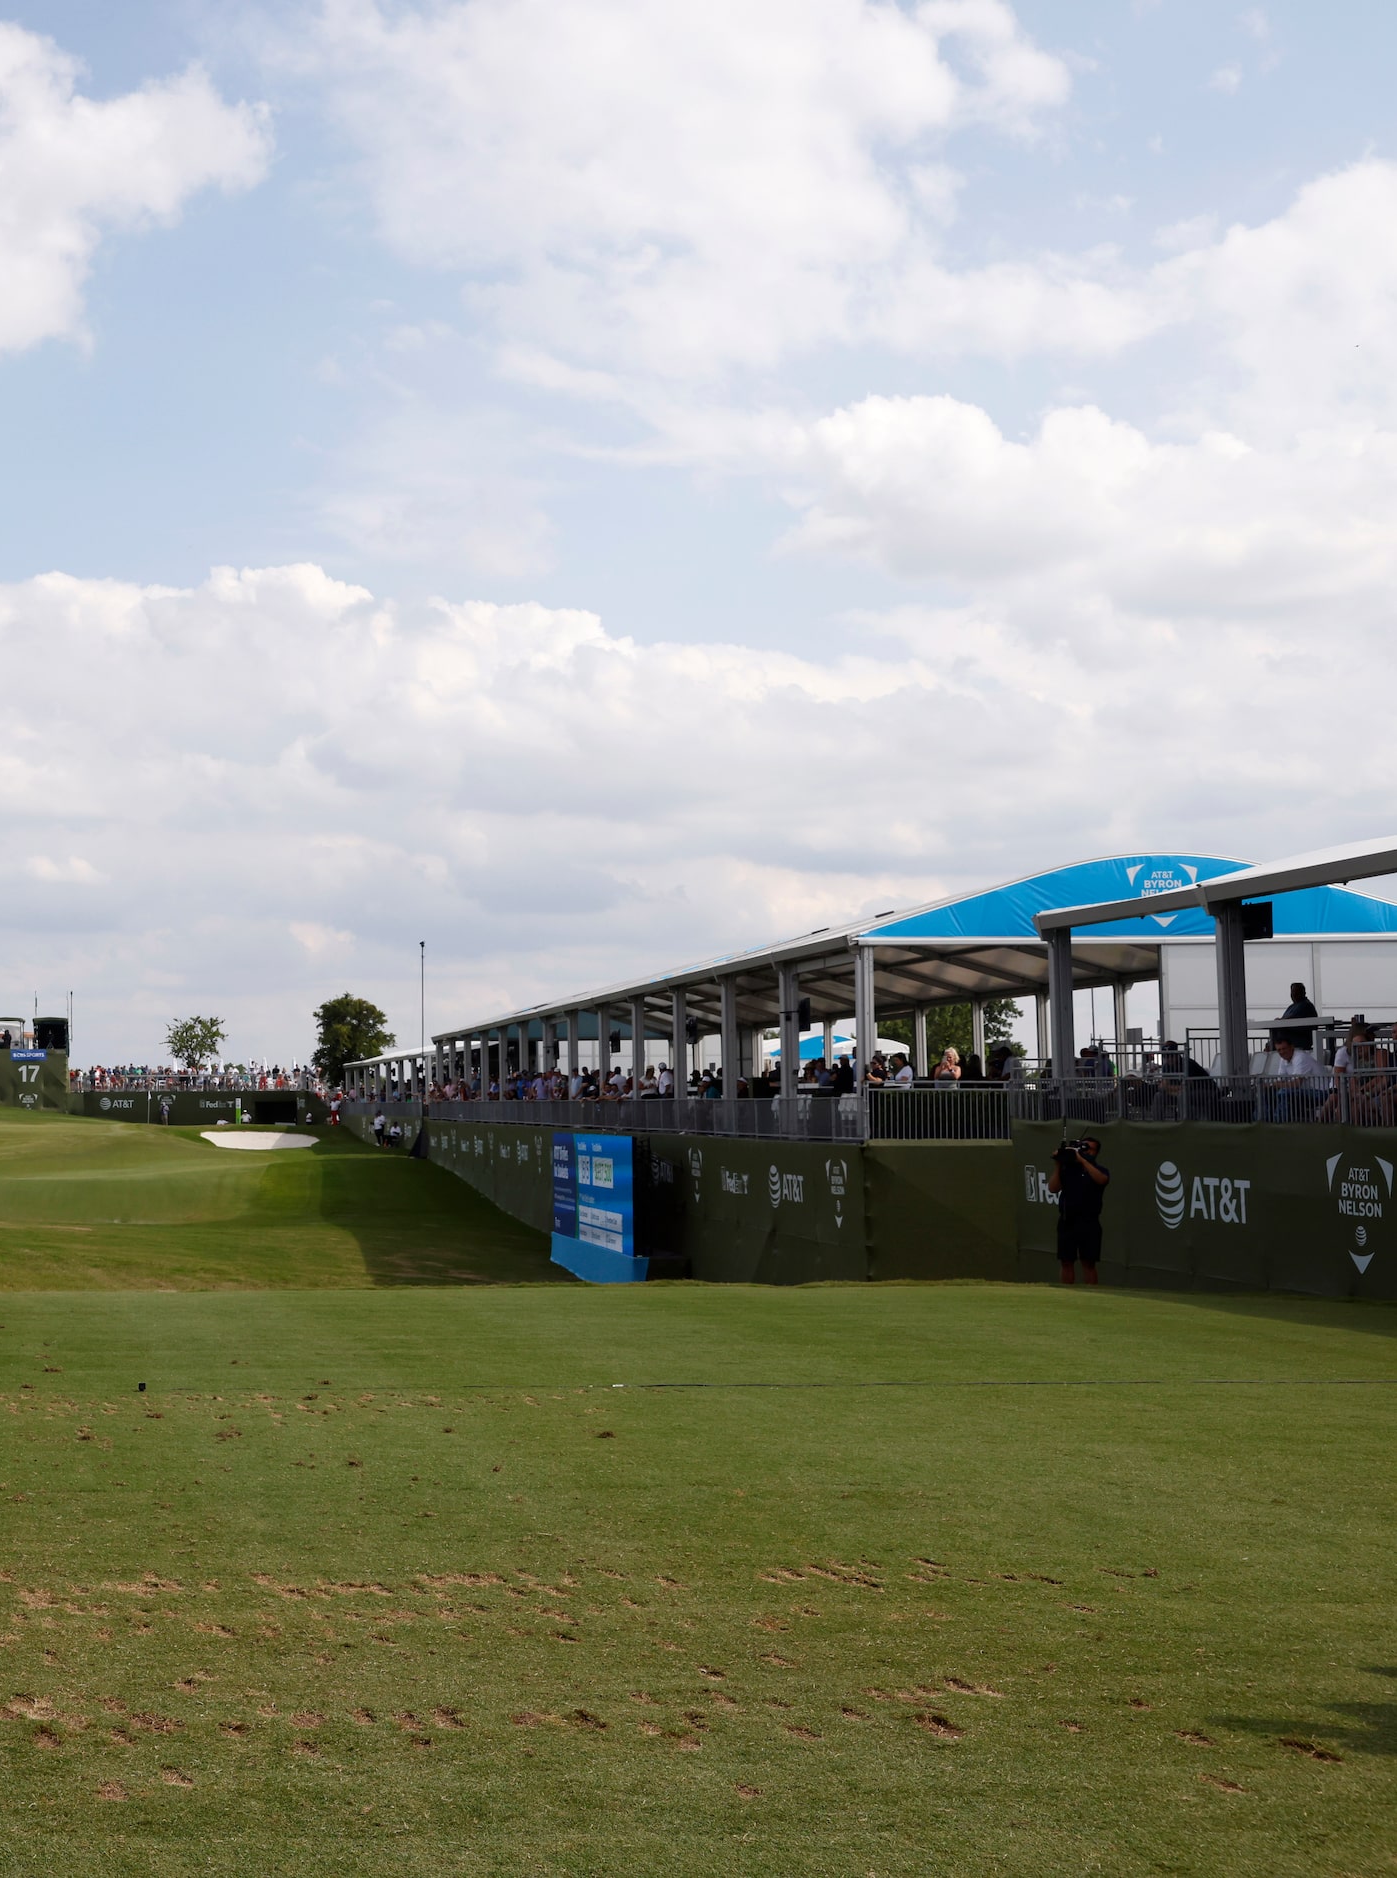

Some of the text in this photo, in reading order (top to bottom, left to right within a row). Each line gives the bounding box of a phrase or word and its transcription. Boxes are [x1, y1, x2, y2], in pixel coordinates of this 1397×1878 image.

[1151, 870, 1174, 880] AT&T
[1143, 880, 1182, 889] BYRON
[1141, 889, 1169, 897] NEL
[17, 1065, 40, 1083] 17
[112, 1100, 134, 1108] AT&T
[1348, 1167, 1371, 1182] AT&T
[782, 1173, 804, 1203] AT&T
[1341, 1182, 1378, 1200] BYRON
[1190, 1176, 1251, 1224] AT&T
[1338, 1198, 1382, 1218] NELSON
